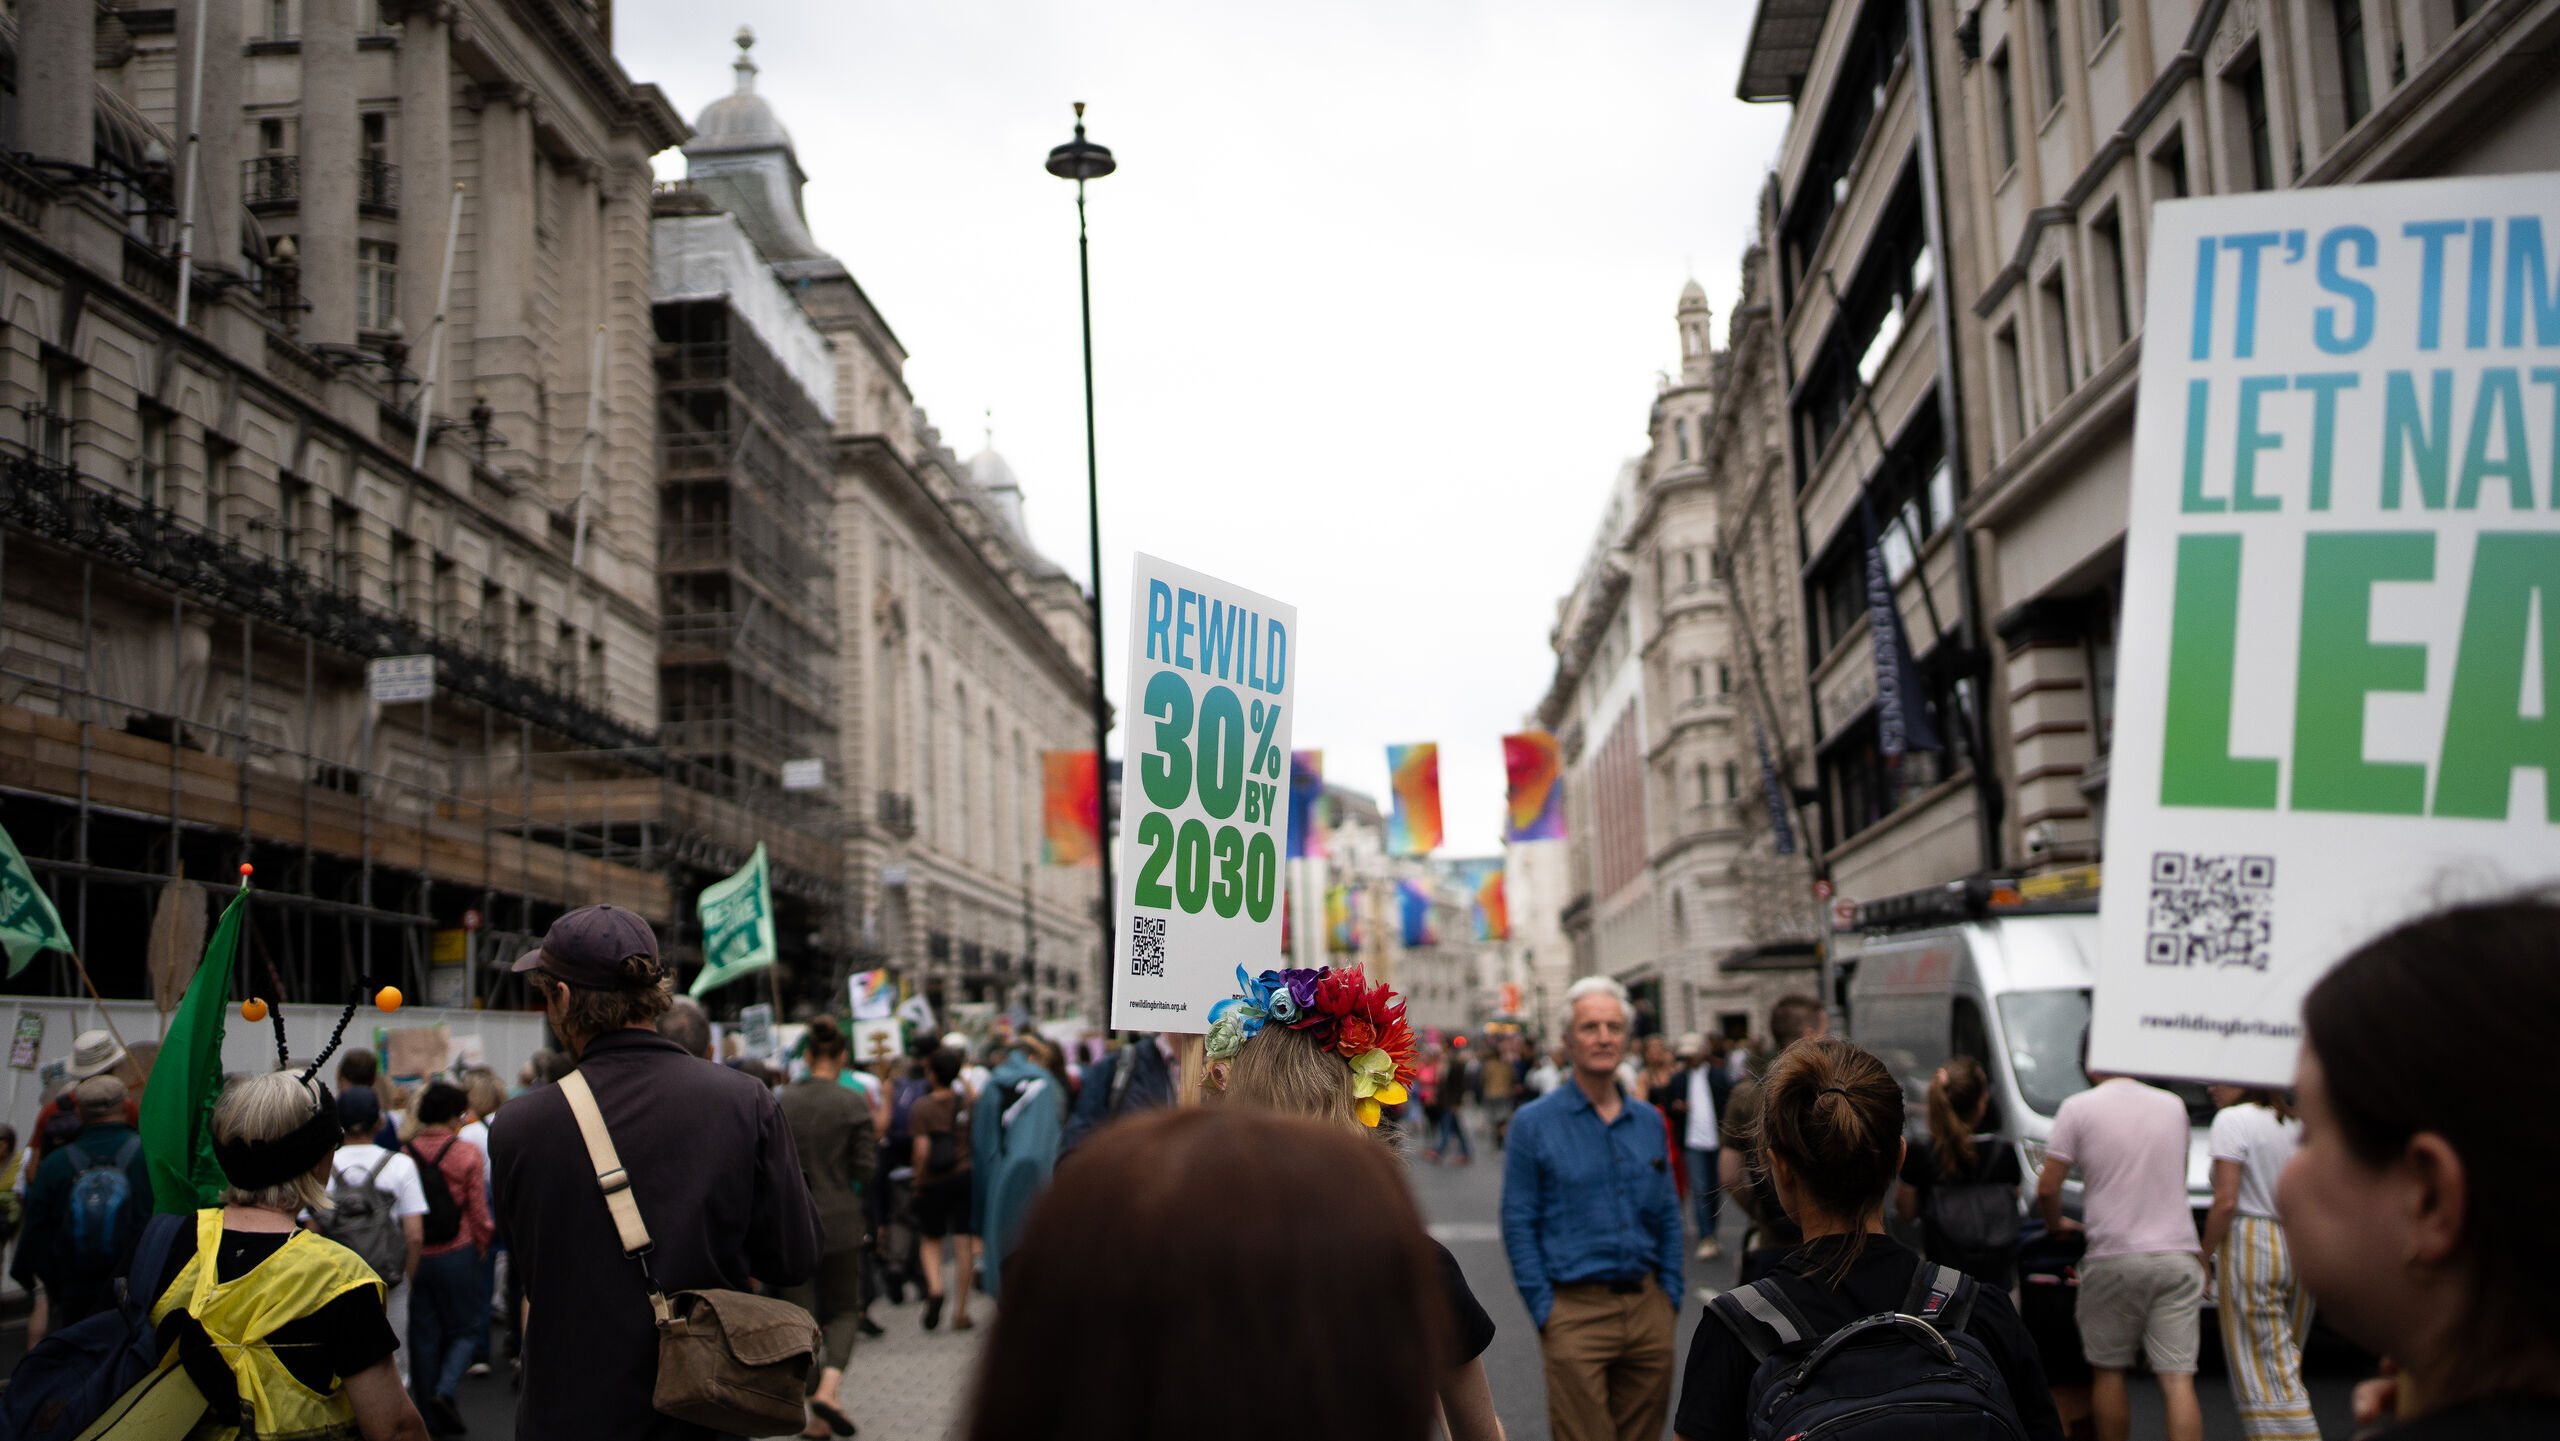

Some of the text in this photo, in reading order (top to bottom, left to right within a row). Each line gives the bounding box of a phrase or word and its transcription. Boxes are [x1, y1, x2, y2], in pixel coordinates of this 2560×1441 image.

[2191, 225, 2379, 361] IT'S
[2182, 372, 2360, 512] LET
[1146, 578, 1287, 695] REWILD
[2161, 533, 2560, 823] LEA
[1141, 671, 1281, 819] 30%
[1245, 779, 1278, 827] BY
[1134, 811, 1276, 923] 2030
[1129, 999, 1187, 1012] rewildingbritain.org.uk
